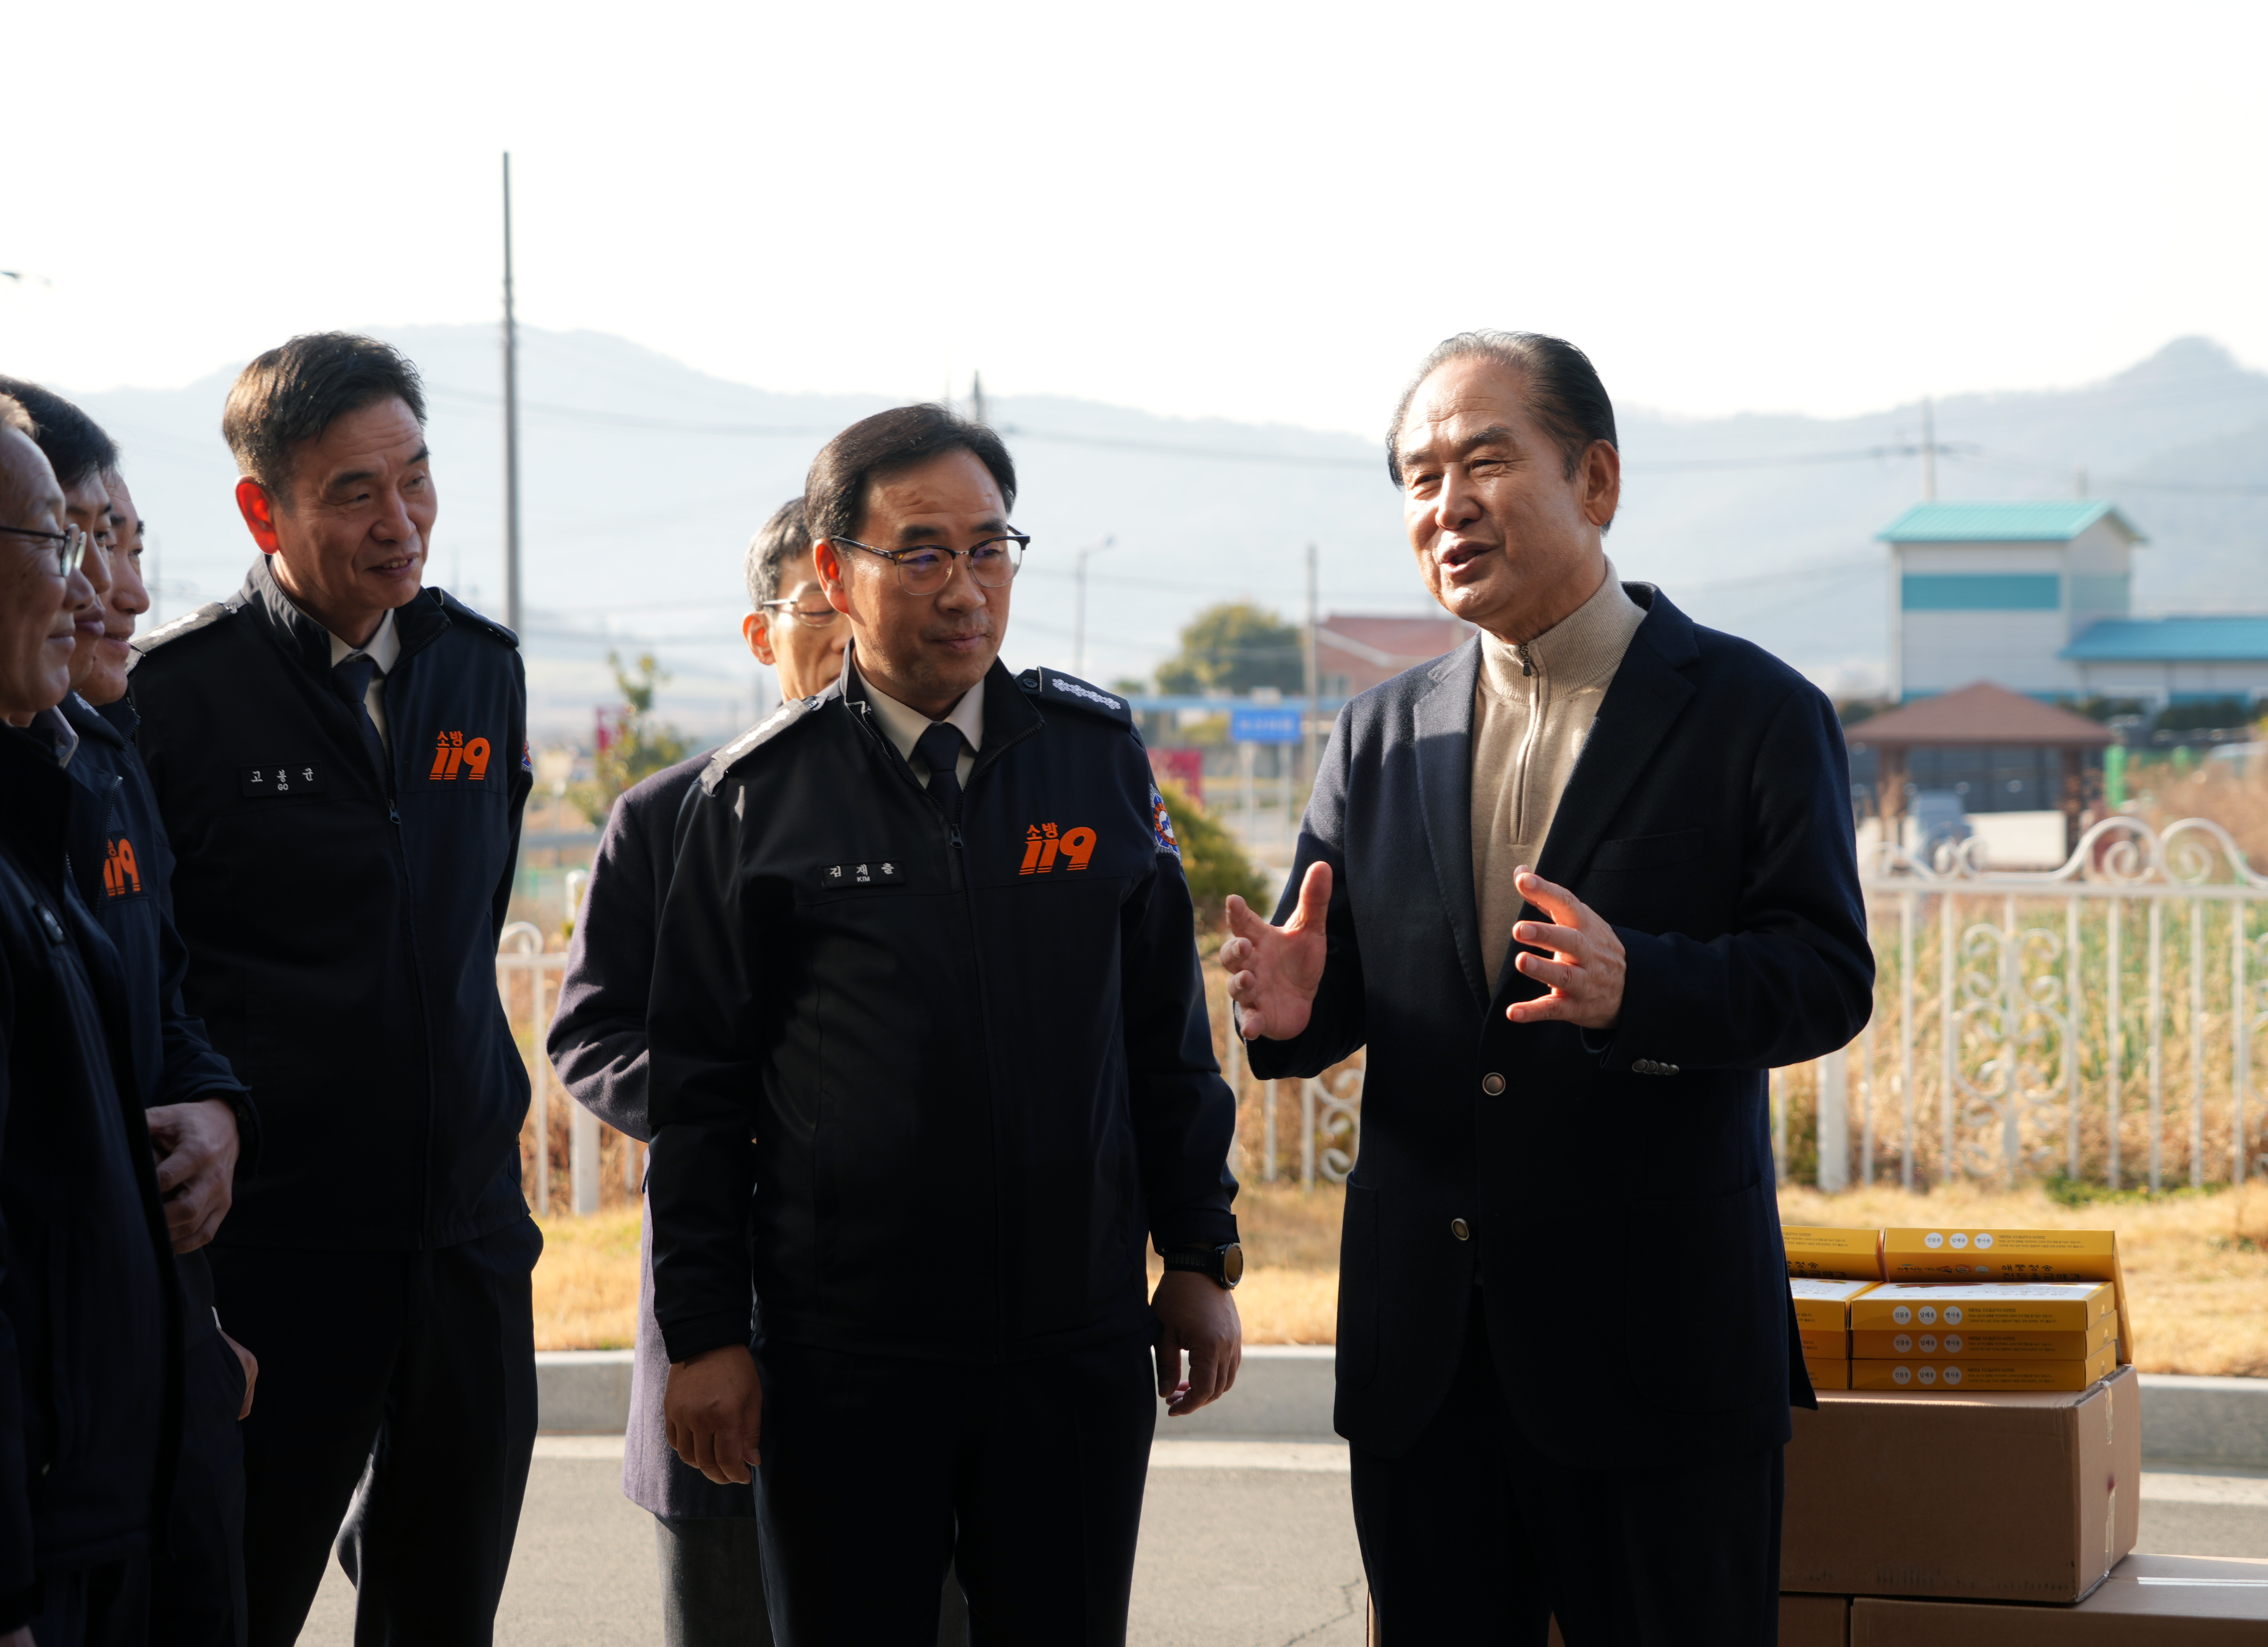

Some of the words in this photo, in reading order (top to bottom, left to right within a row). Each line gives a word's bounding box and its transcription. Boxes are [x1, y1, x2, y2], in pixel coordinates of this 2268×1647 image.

[436, 731, 463, 747] 소방
[429, 737, 490, 780] 119
[1026, 822, 1058, 840] 소방
[1019, 826, 1097, 875] 119
[1789, 1269, 1848, 1279] 도울금약과
